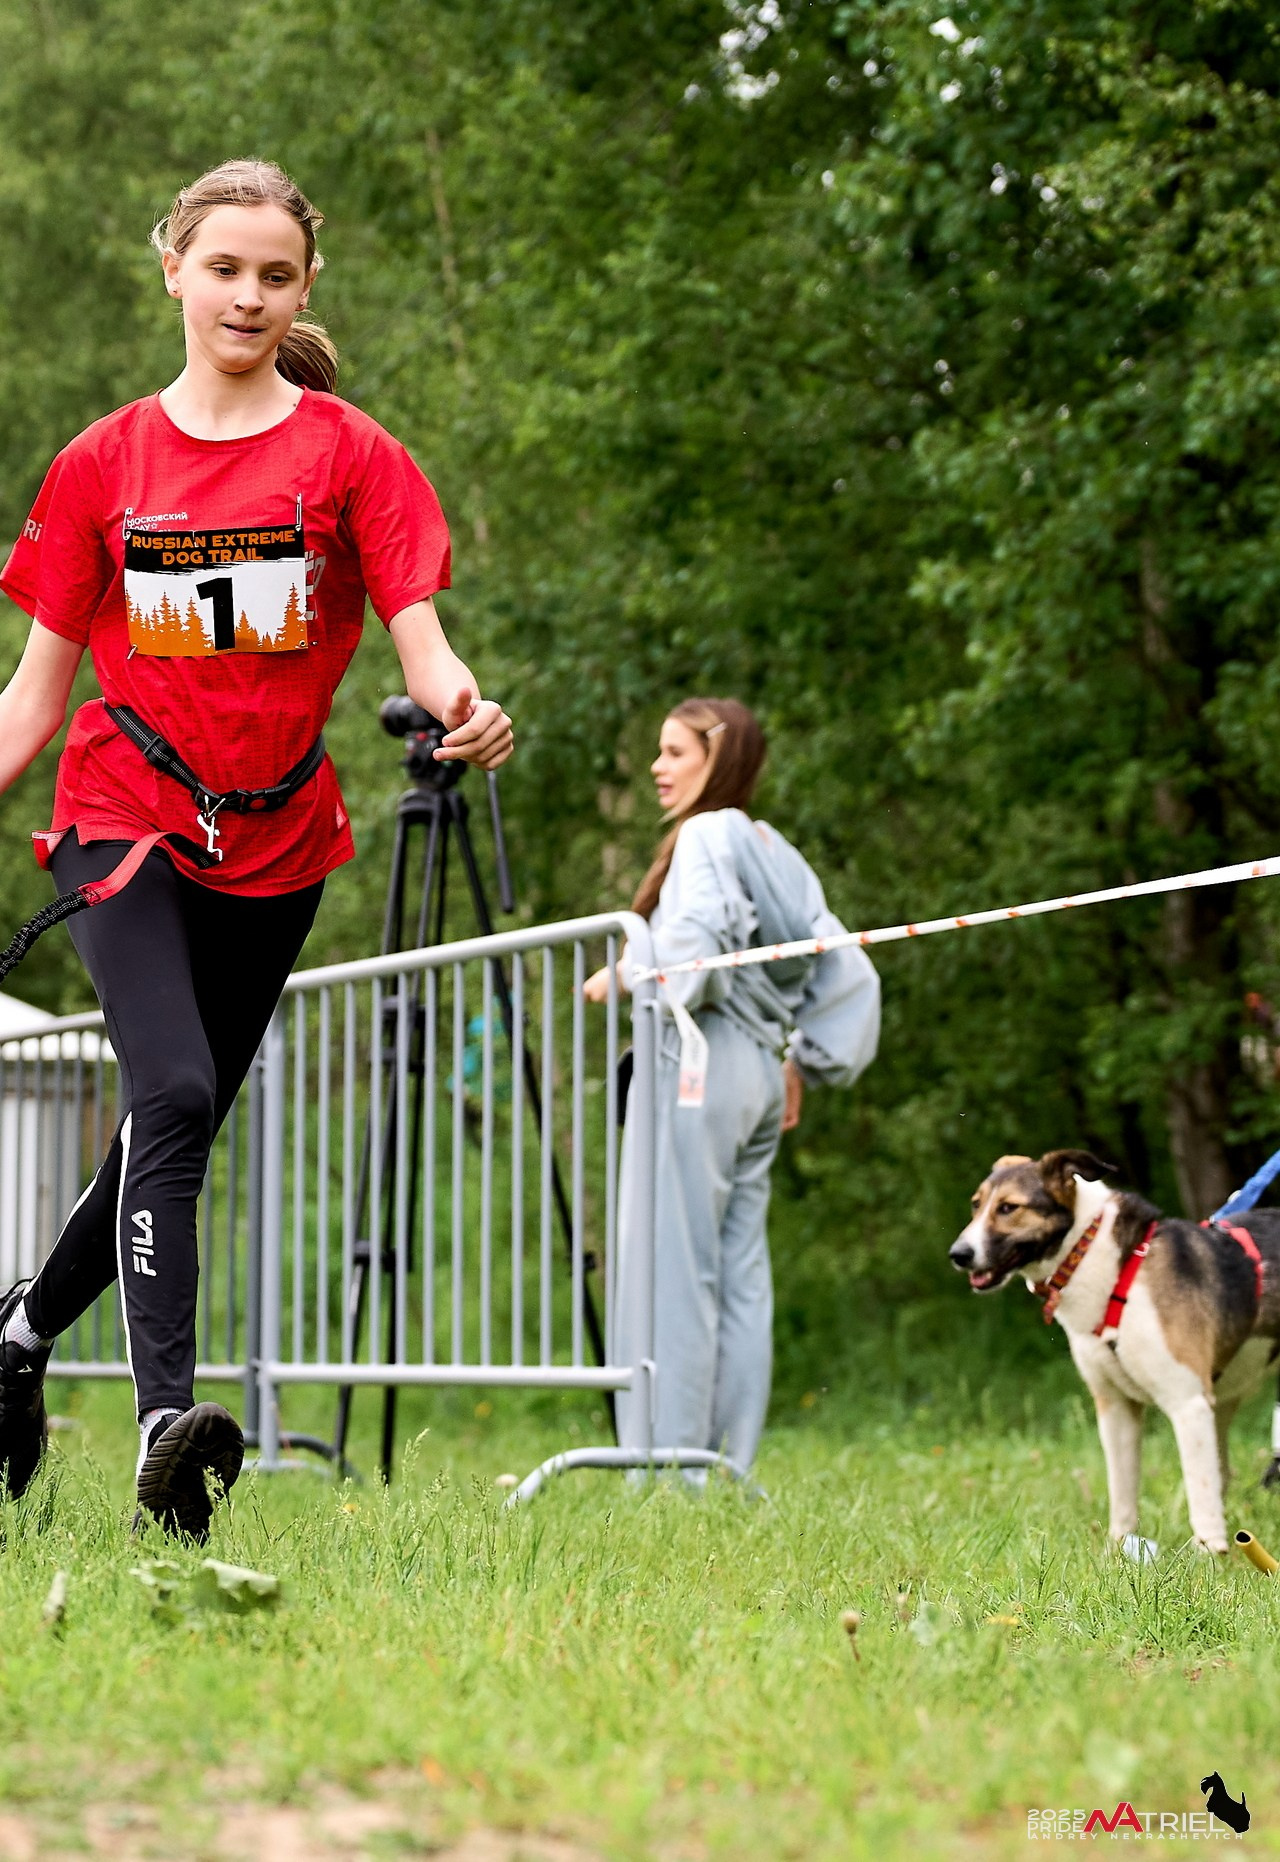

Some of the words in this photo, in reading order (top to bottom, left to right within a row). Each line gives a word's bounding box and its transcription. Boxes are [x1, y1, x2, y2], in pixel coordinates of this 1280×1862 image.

[127, 512, 188, 527] МОСКОВСКИЙ
[132, 534, 206, 550] RUSSIAN
[212, 530, 295, 547] EXTREME
[162, 550, 204, 565] DOG
[208, 548, 264, 562] TRAIL
[195, 576, 236, 651] 1
[131, 1209, 158, 1277] FILA
